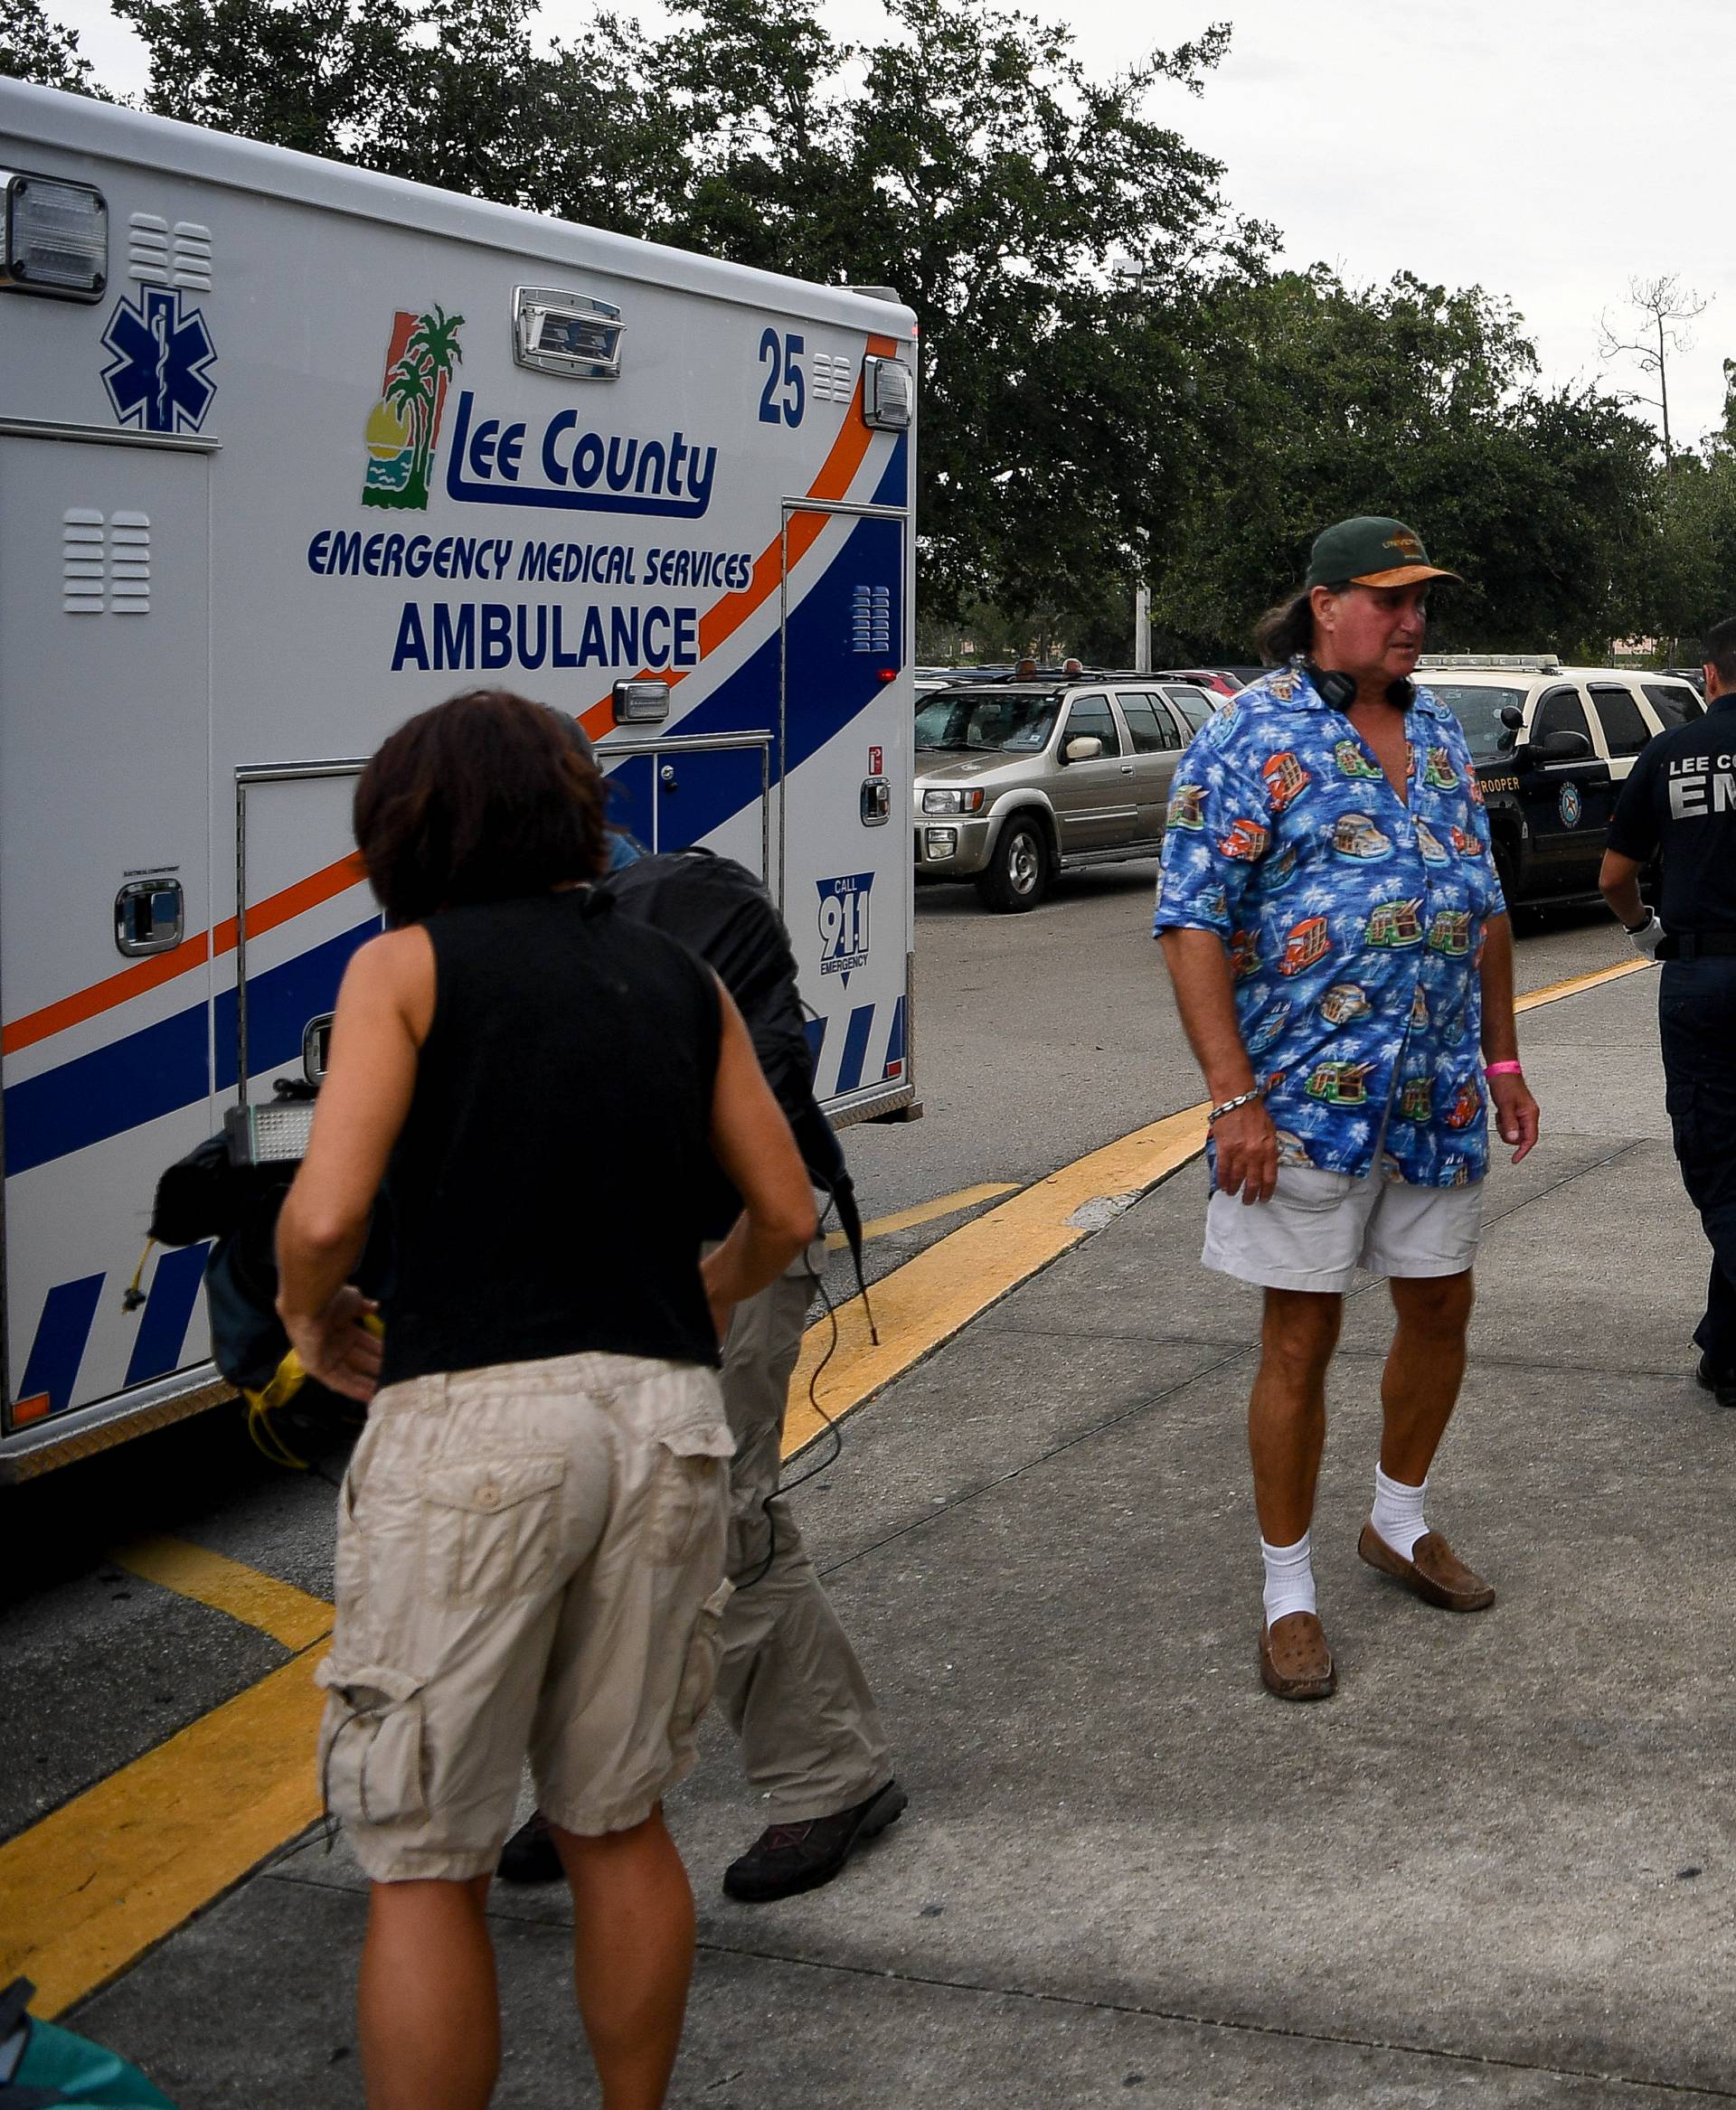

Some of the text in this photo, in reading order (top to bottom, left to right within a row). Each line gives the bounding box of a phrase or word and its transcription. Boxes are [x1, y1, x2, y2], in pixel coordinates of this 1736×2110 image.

[759, 327, 806, 429] 25
[542, 409, 718, 519] County
[307, 530, 751, 589] EMERGENCY MEDICAL SERVICES
[391, 601, 697, 671] AMBULANCE
[1476, 776, 1520, 794] ROOPER
[1669, 756, 1710, 776] LEE
[835, 877, 858, 894] CALL
[820, 954, 869, 976] EMERGENCY
